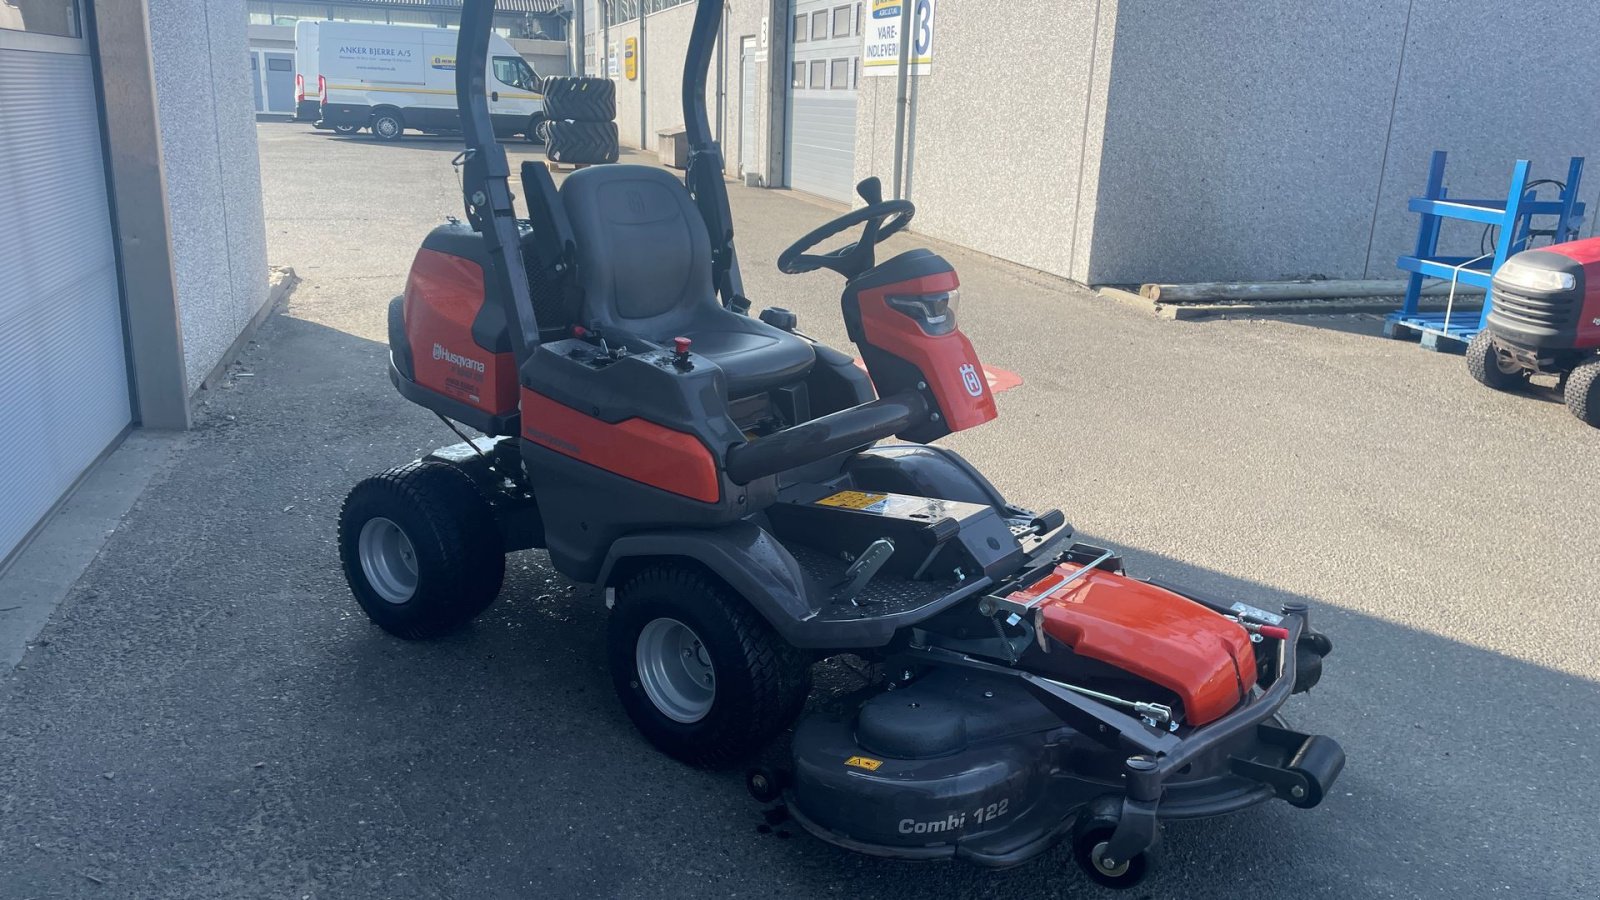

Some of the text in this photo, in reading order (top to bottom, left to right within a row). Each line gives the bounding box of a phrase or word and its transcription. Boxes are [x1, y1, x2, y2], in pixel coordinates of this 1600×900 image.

[762, 22, 767, 43] 3
[877, 25, 897, 40] VARE-
[915, 0, 931, 55] 3
[339, 46, 412, 57] ANKER BJERRE A/S
[866, 43, 899, 58] INDLEVERI
[441, 347, 485, 373] Husqvarna
[898, 798, 1009, 834] Combi 122
